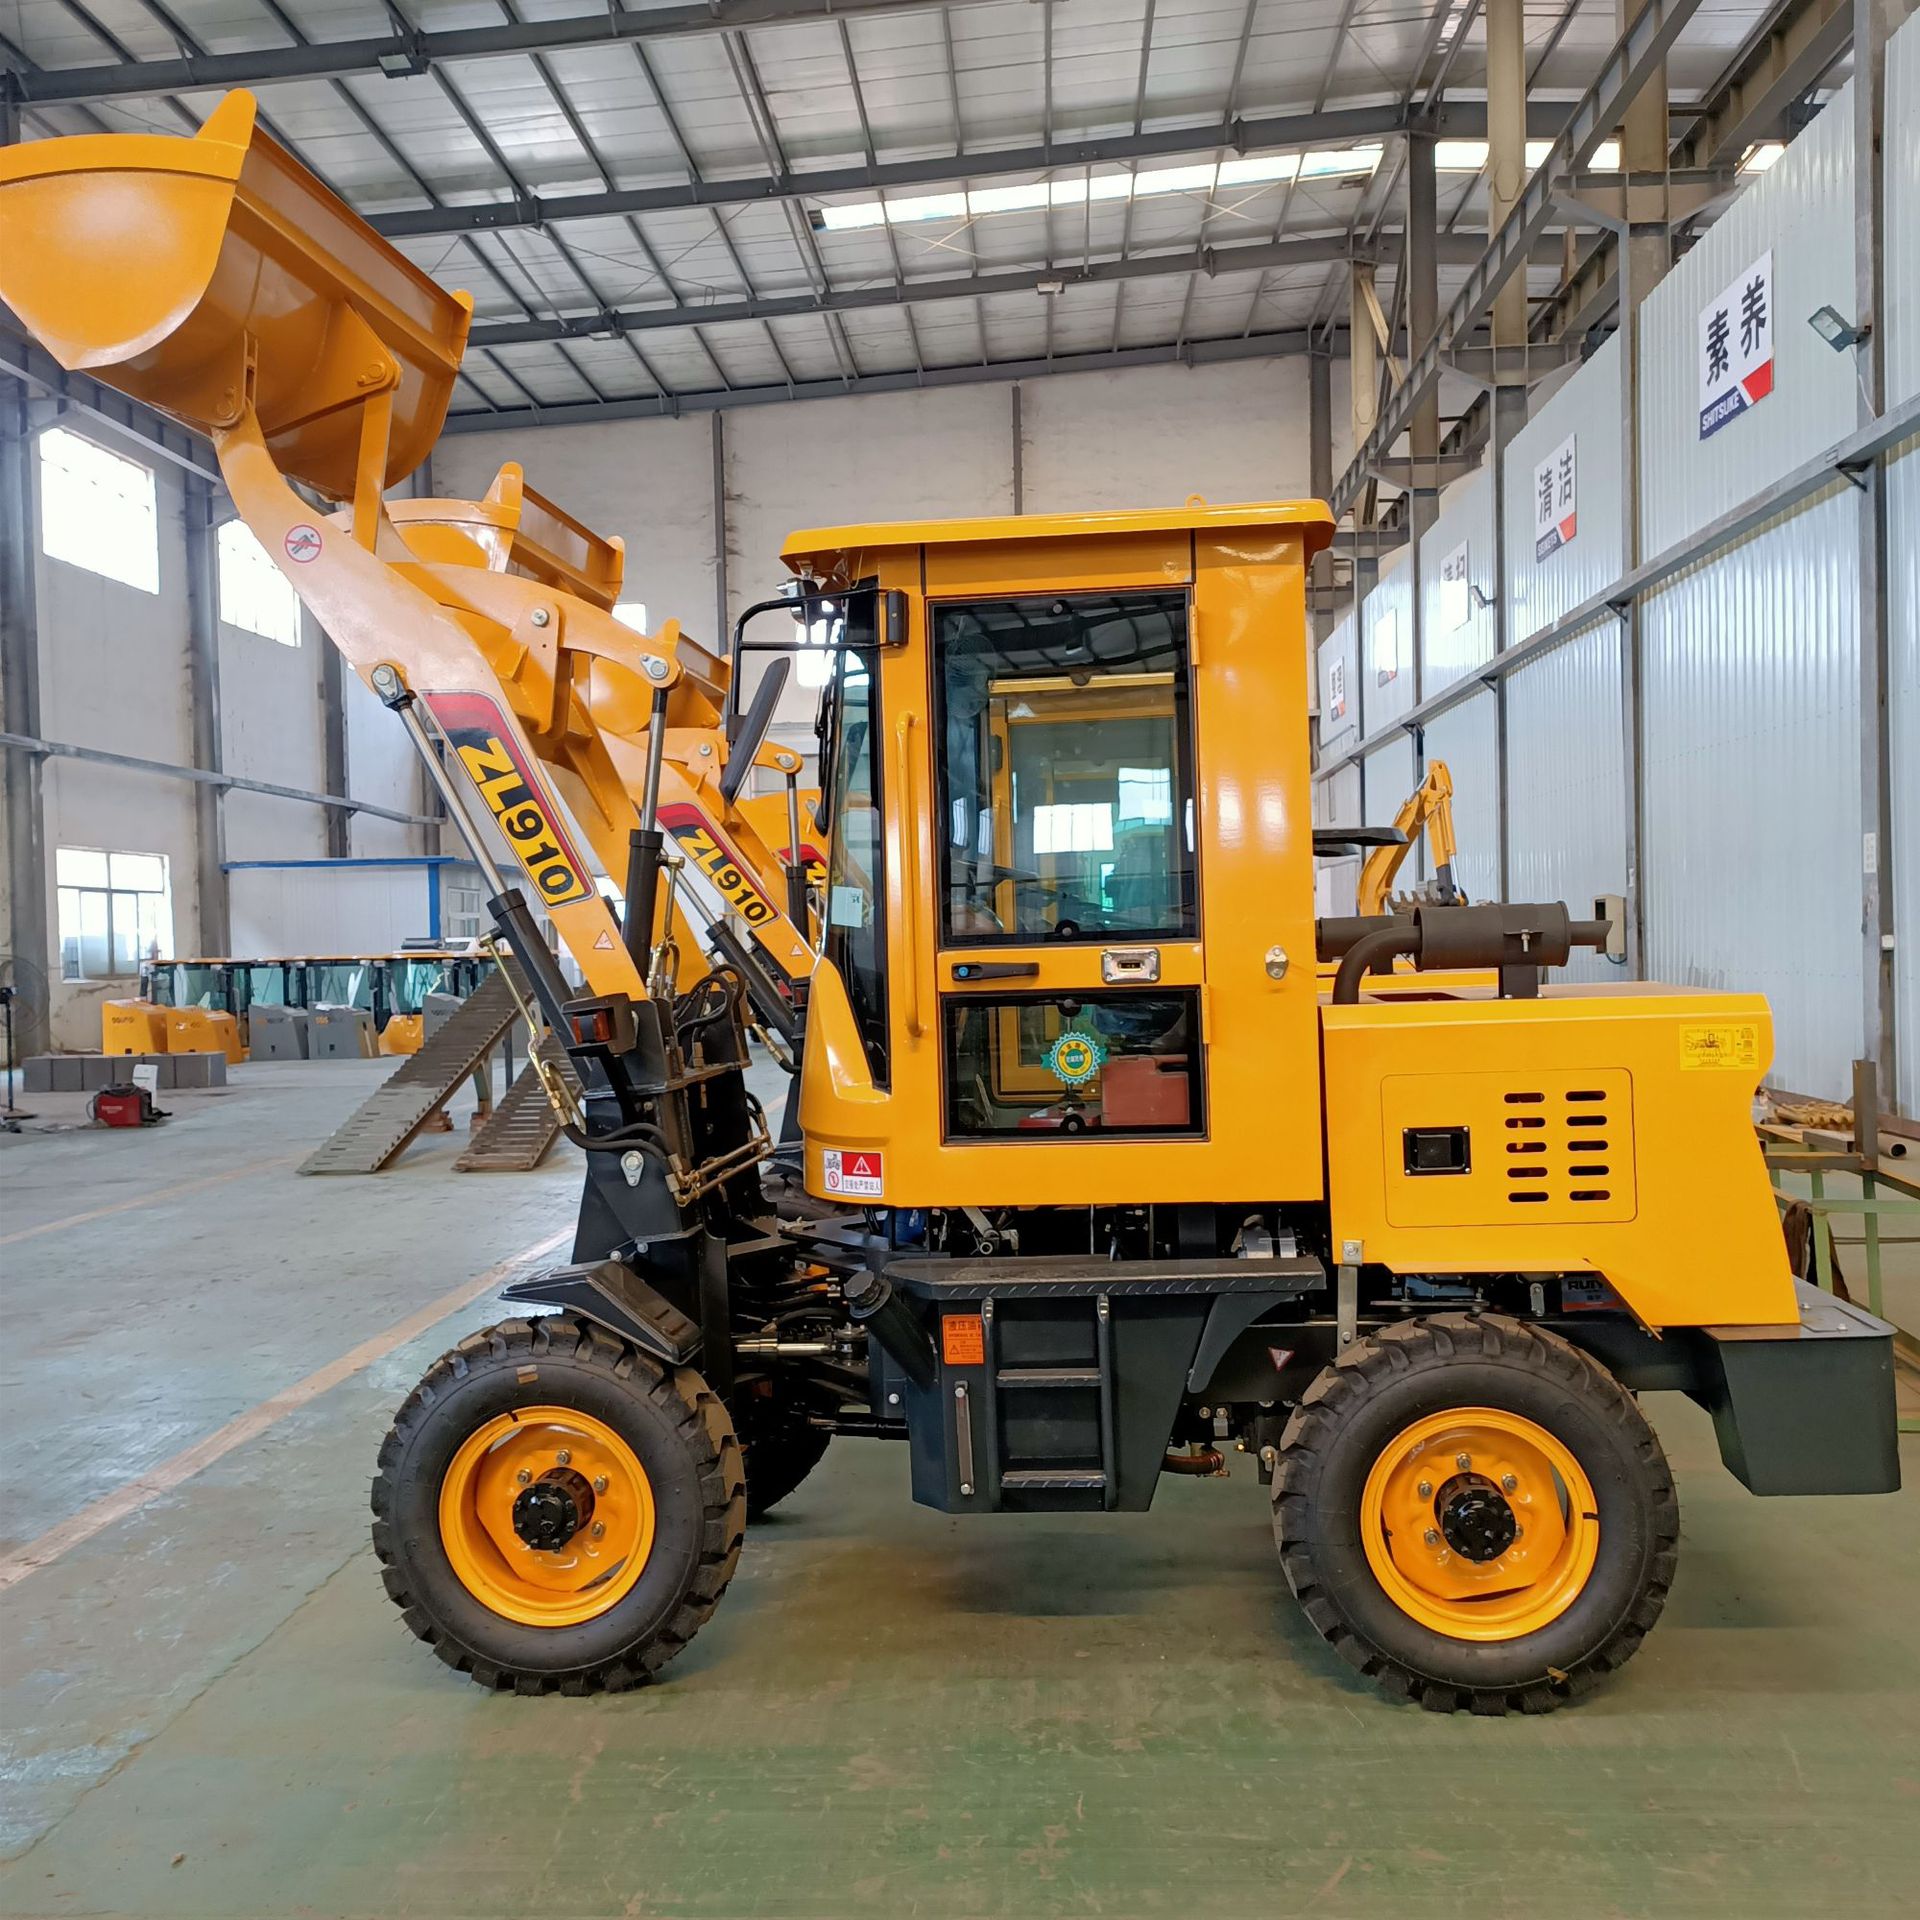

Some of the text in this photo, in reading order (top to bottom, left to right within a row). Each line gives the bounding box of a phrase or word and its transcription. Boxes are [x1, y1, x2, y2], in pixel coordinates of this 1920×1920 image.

[1706, 274, 1767, 386] 素养
[1702, 391, 1740, 431] SHITSUKE
[1539, 449, 1573, 523] 清洁
[457, 737, 575, 896] ZL910
[678, 827, 768, 922] ZL910
